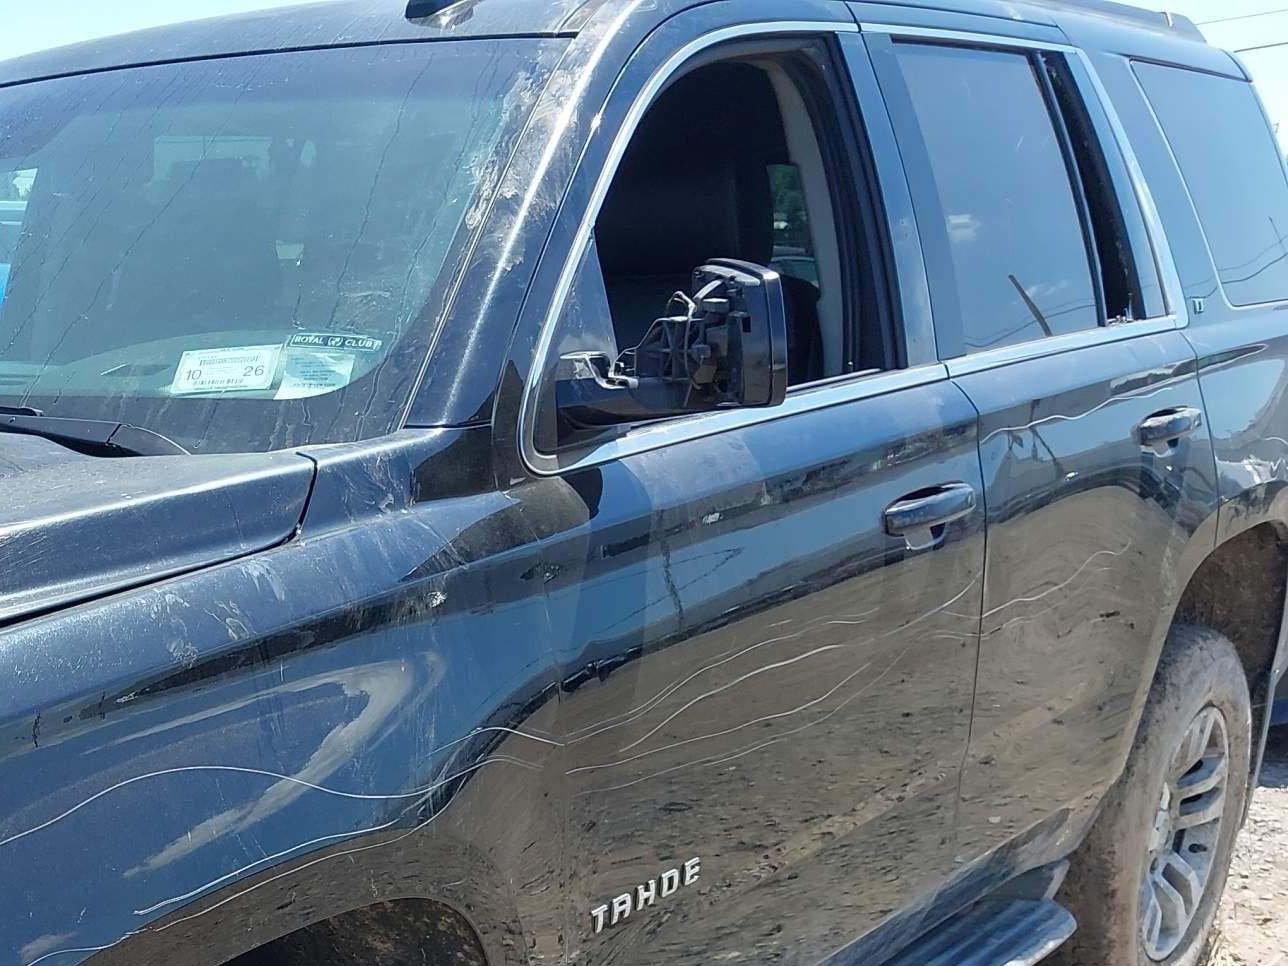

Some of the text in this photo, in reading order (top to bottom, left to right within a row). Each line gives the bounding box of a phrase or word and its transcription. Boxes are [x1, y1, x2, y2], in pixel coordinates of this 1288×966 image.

[295, 335, 373, 348] ROYAL CLUB
[186, 369, 202, 381] 10
[243, 365, 265, 377] 26
[590, 856, 701, 934] TAHOE
